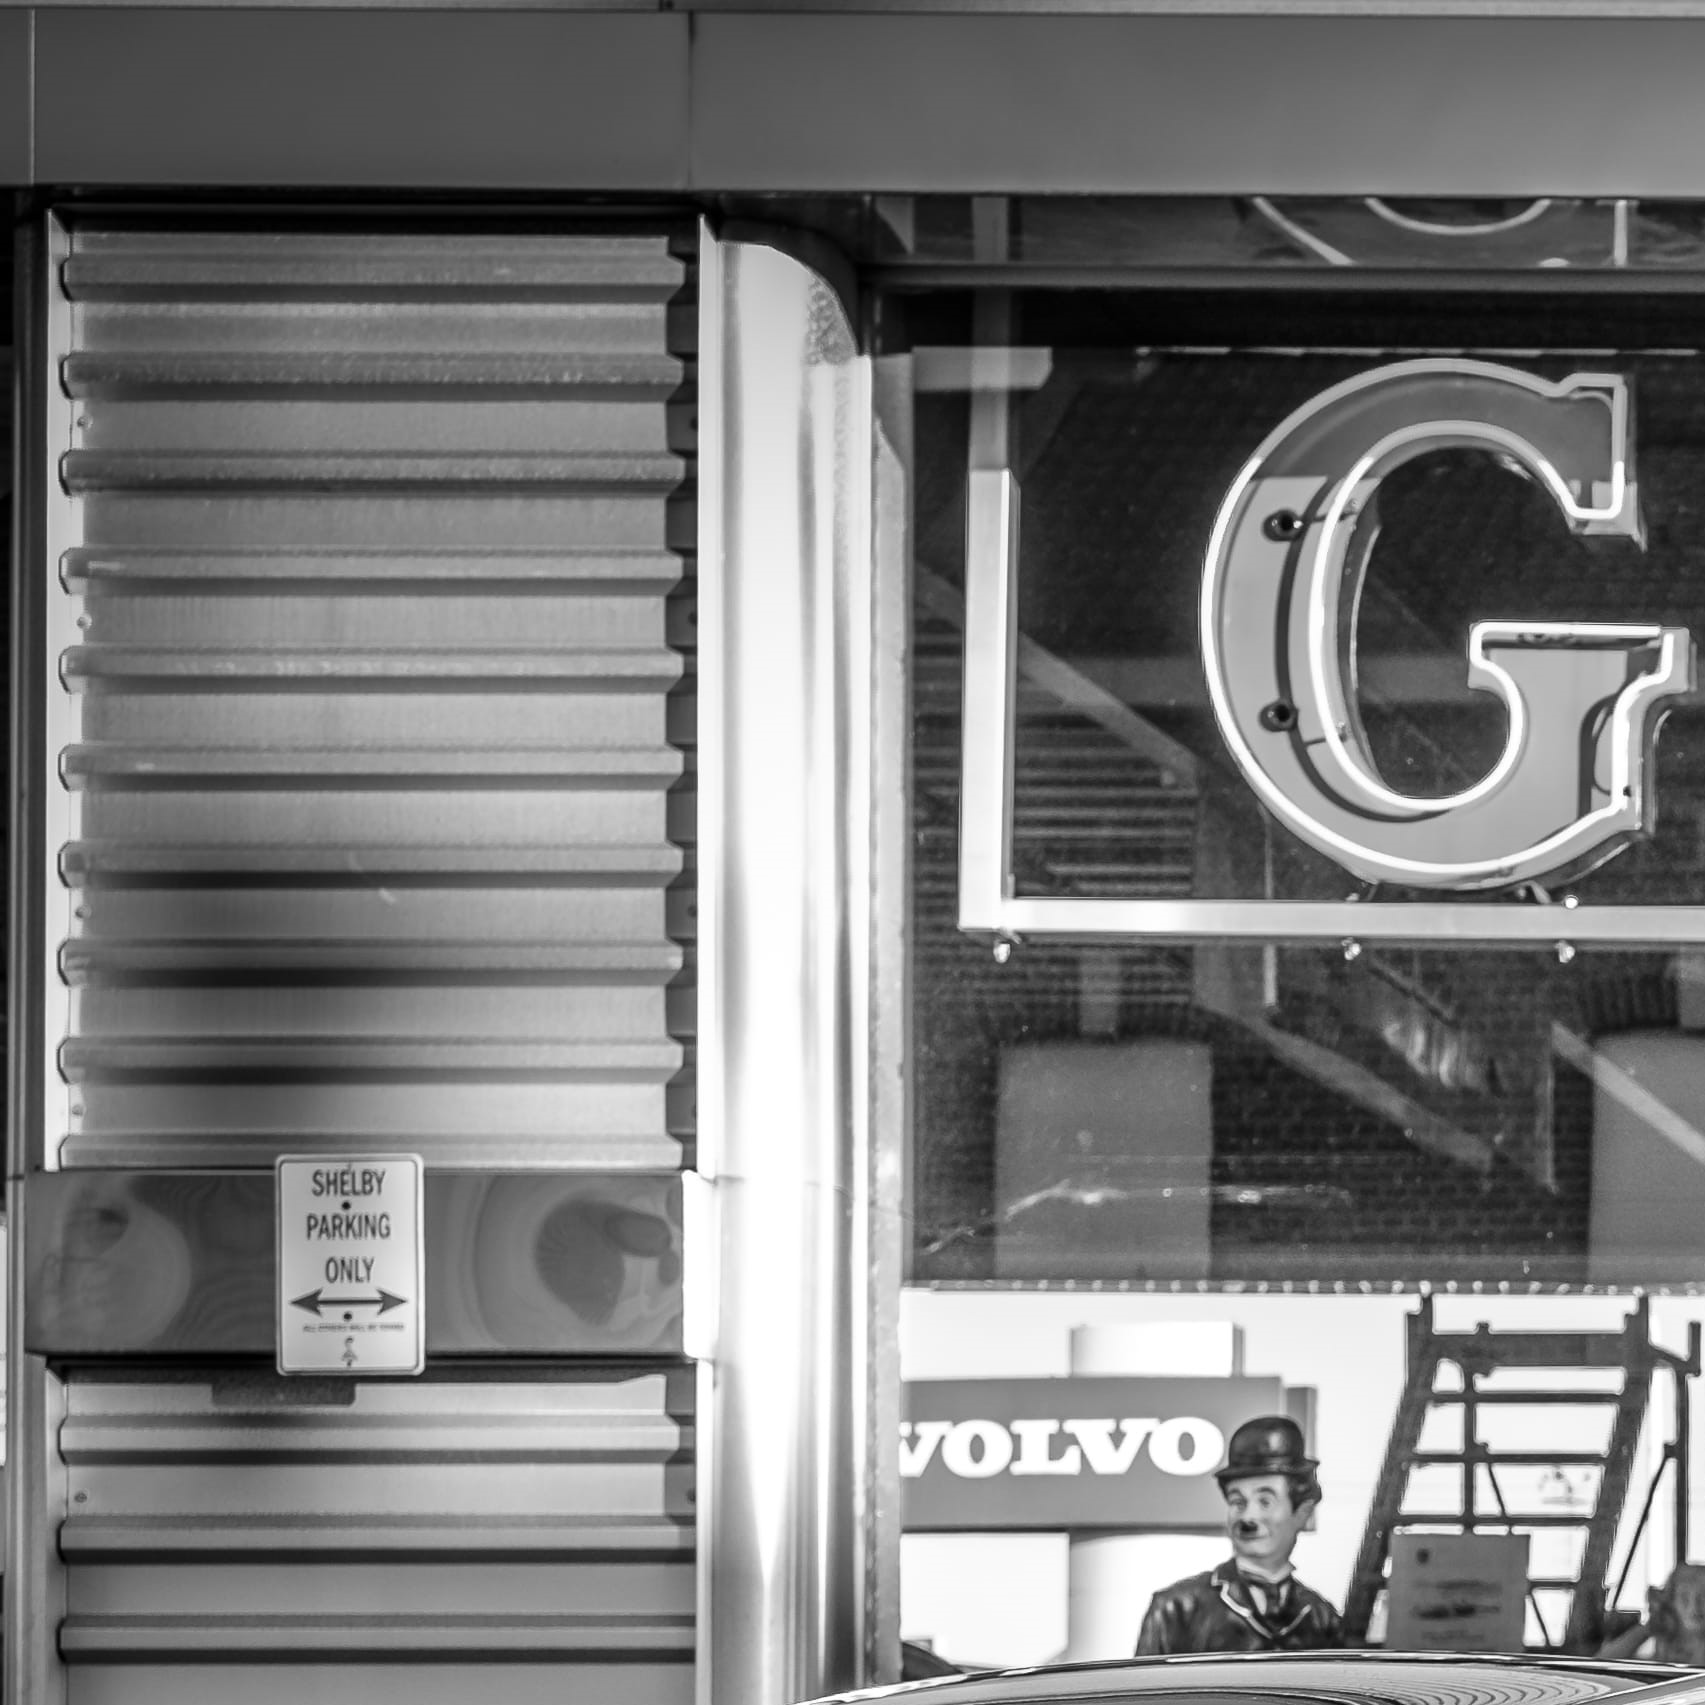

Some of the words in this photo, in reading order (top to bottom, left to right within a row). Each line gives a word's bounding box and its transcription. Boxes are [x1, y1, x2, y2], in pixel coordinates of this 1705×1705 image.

[311, 1168, 386, 1197] SHELBY
[306, 1213, 392, 1240] PARKING
[324, 1256, 375, 1284] ONLY
[900, 1416, 1225, 1477] VOLVO
